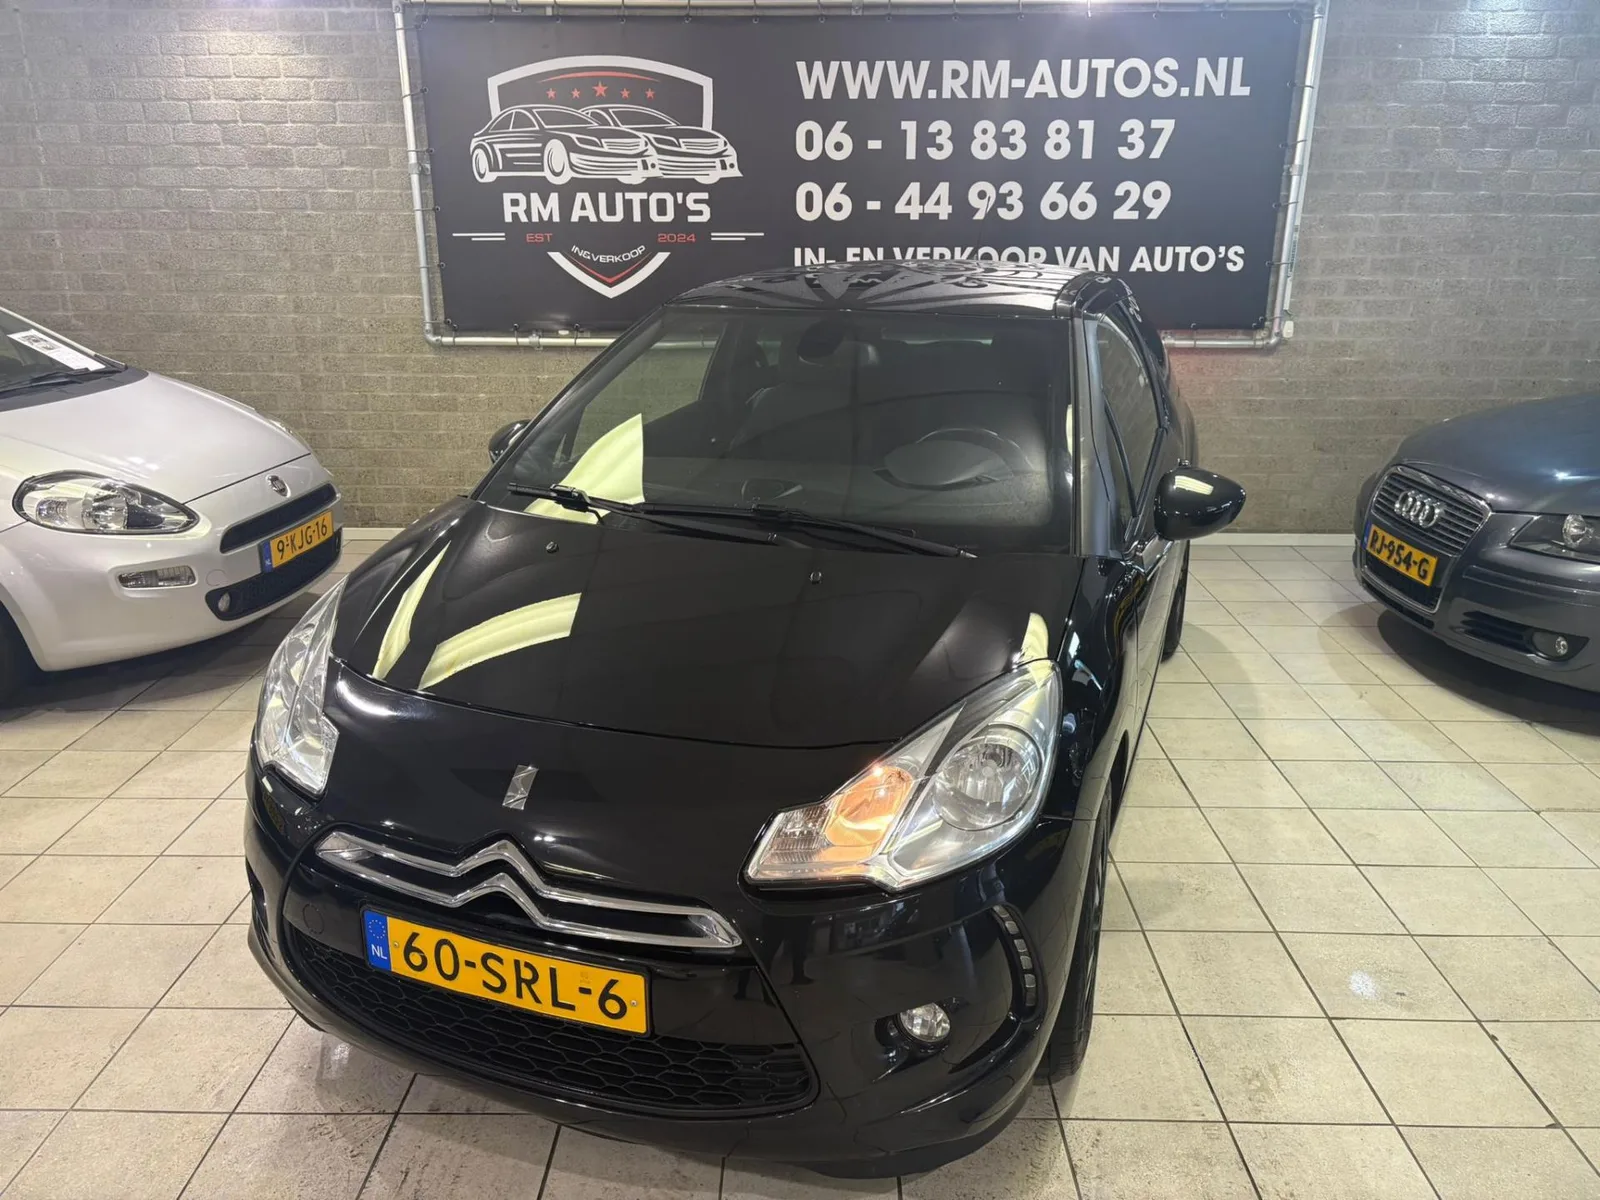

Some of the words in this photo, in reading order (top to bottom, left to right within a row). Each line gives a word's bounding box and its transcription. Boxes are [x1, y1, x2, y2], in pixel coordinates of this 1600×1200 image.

[796, 57, 1251, 100] WWW.RM-AUTOS.NL
[795, 120, 853, 161] 06
[867, 139, 883, 150] -
[900, 120, 954, 161] 13
[970, 119, 1027, 161] 83
[1043, 119, 1095, 161] 81
[1117, 118, 1176, 160] 37
[503, 192, 561, 223] RM
[570, 192, 711, 223] AUTO'S
[795, 181, 853, 222] 06
[866, 200, 881, 210] -
[894, 181, 953, 221] 44
[967, 180, 1024, 221] 93
[1039, 181, 1098, 221] 66
[1112, 180, 1172, 220] 29
[526, 233, 553, 243] EST
[657, 233, 696, 243] 2024
[1054, 246, 1120, 272] VAN
[1128, 246, 1245, 273] AUTO'S
[276, 518, 328, 560] 9-KJG-16
[1370, 530, 1430, 580] RJ-954-G
[371, 943, 388, 960] NL
[403, 932, 628, 1020] 60-SRL-6
